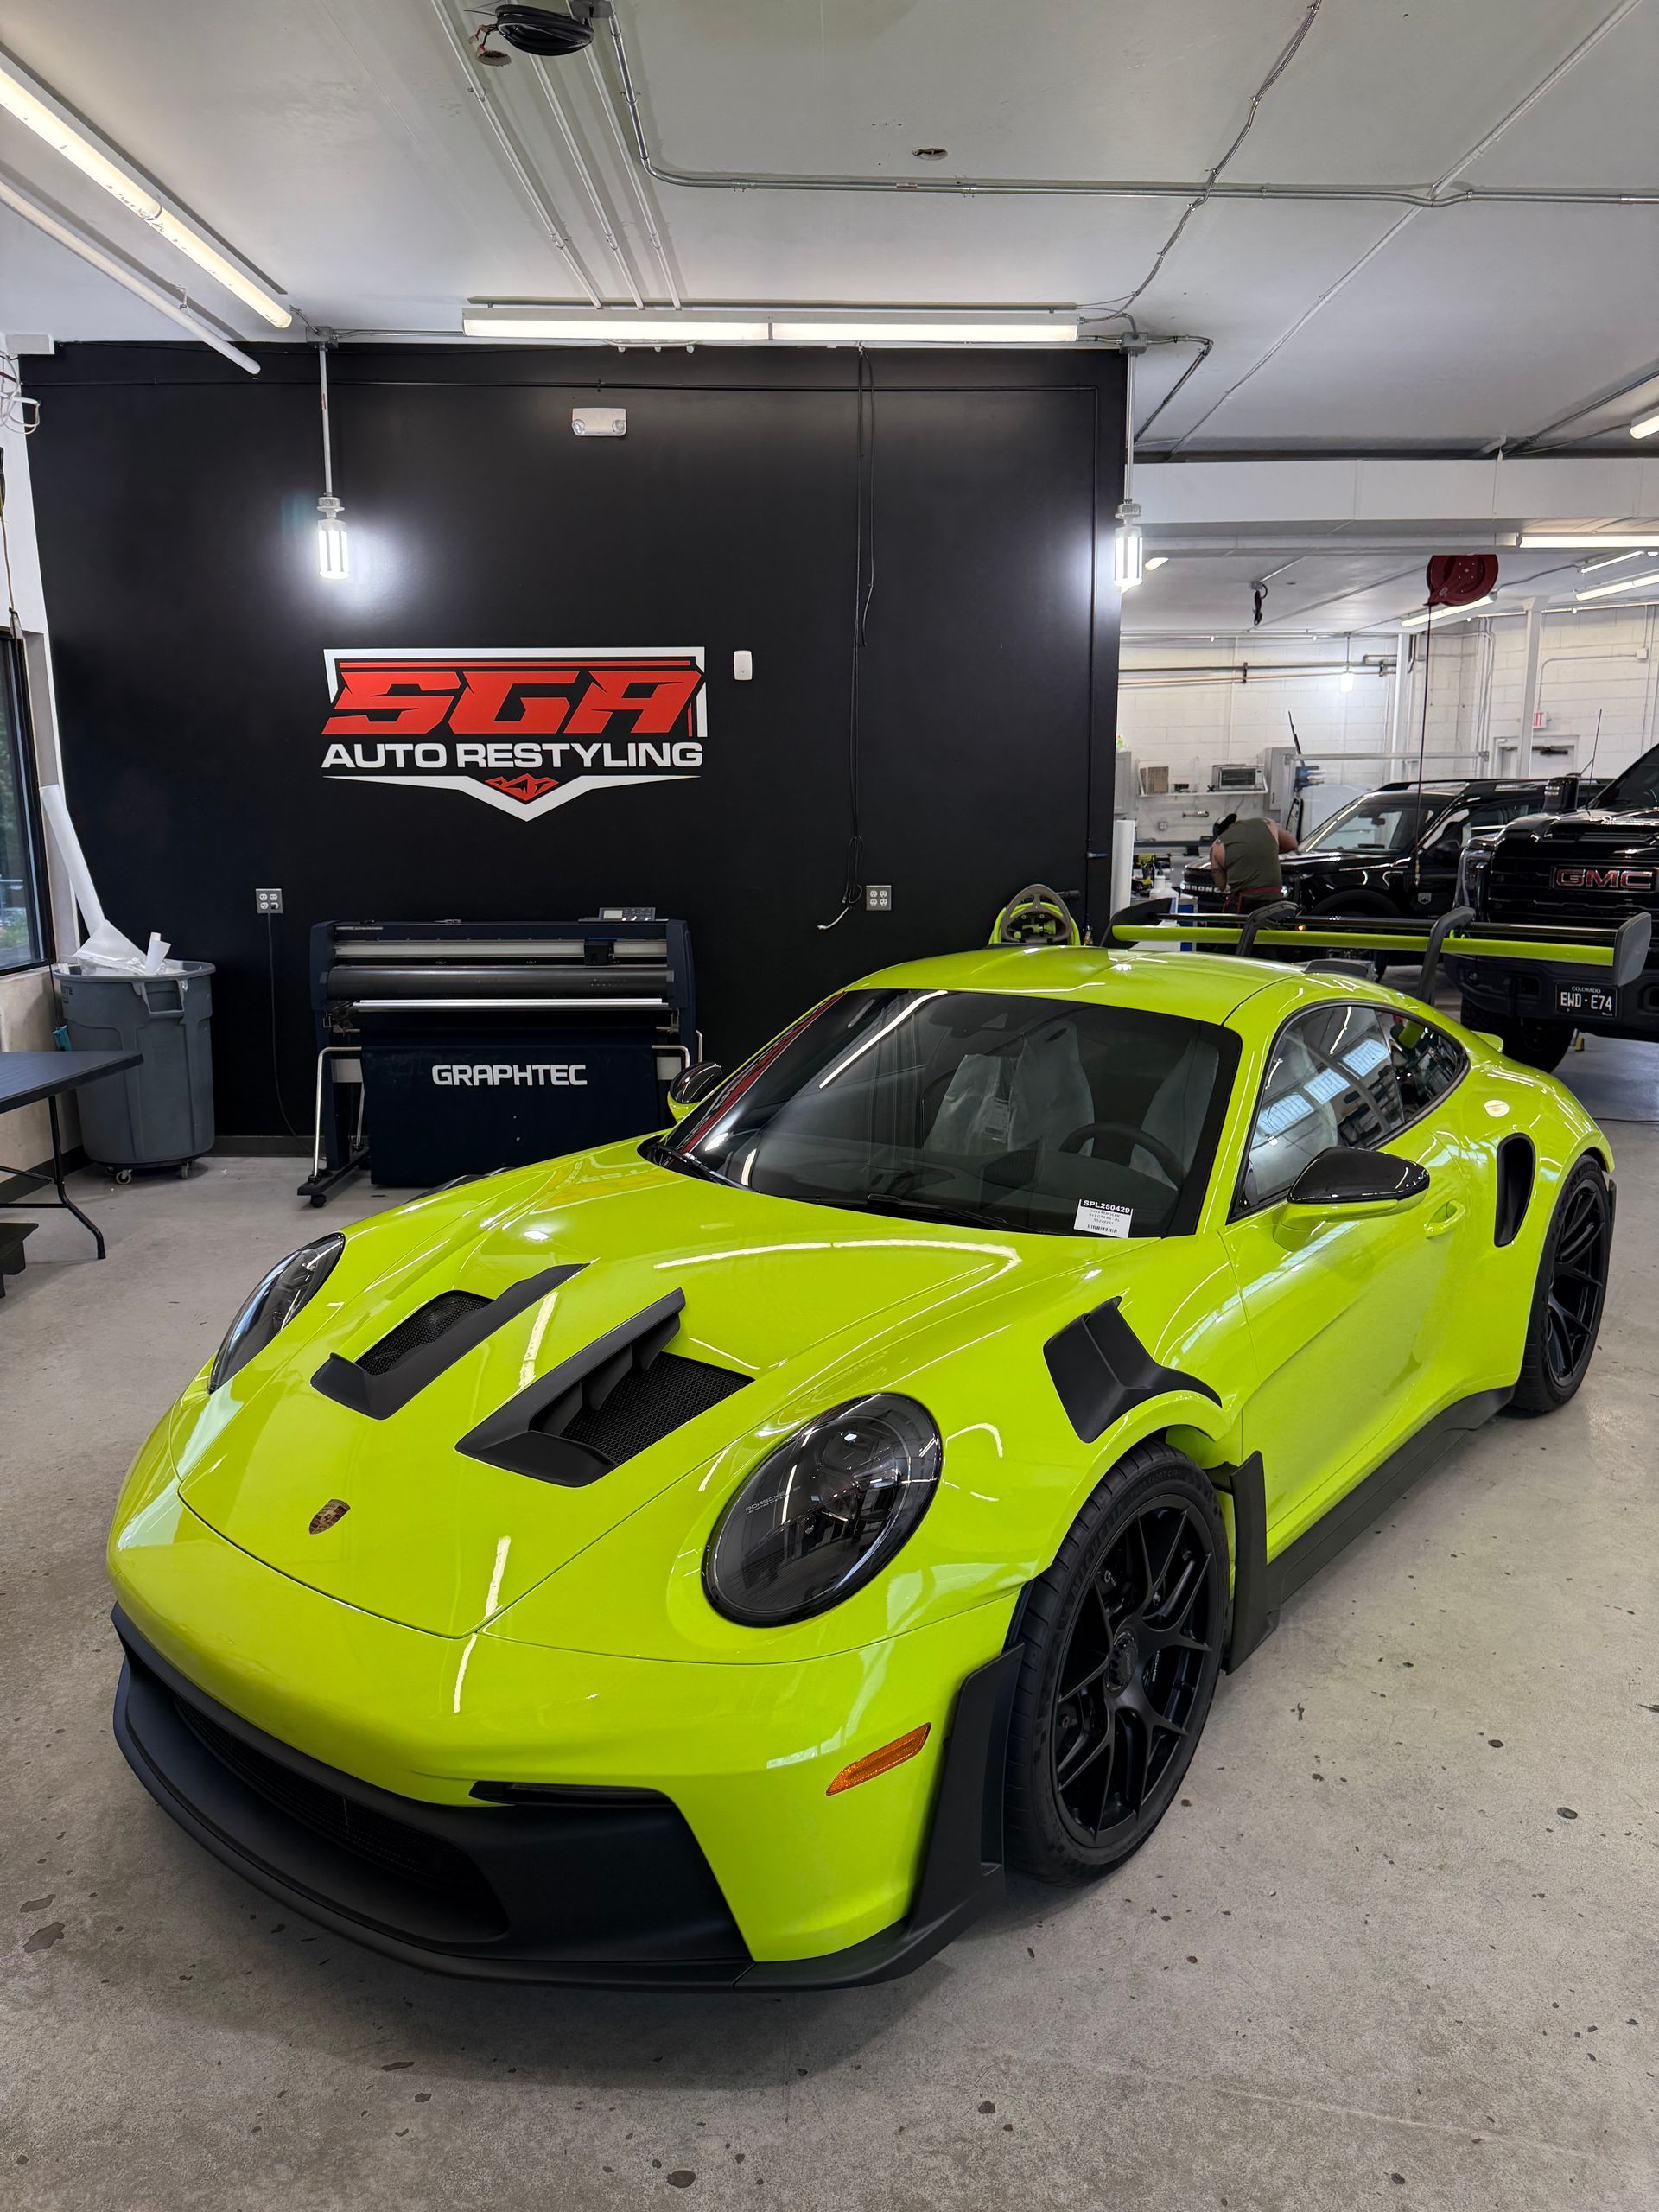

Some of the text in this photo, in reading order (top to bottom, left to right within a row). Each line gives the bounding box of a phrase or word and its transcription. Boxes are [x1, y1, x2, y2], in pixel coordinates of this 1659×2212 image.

[321, 671, 702, 734] SGA
[321, 741, 703, 768] AUTO RESTYLING
[1556, 869, 1652, 889] GMC
[432, 1064, 588, 1086] GRAPHTEC
[1083, 1199, 1130, 1214] SPL250429
